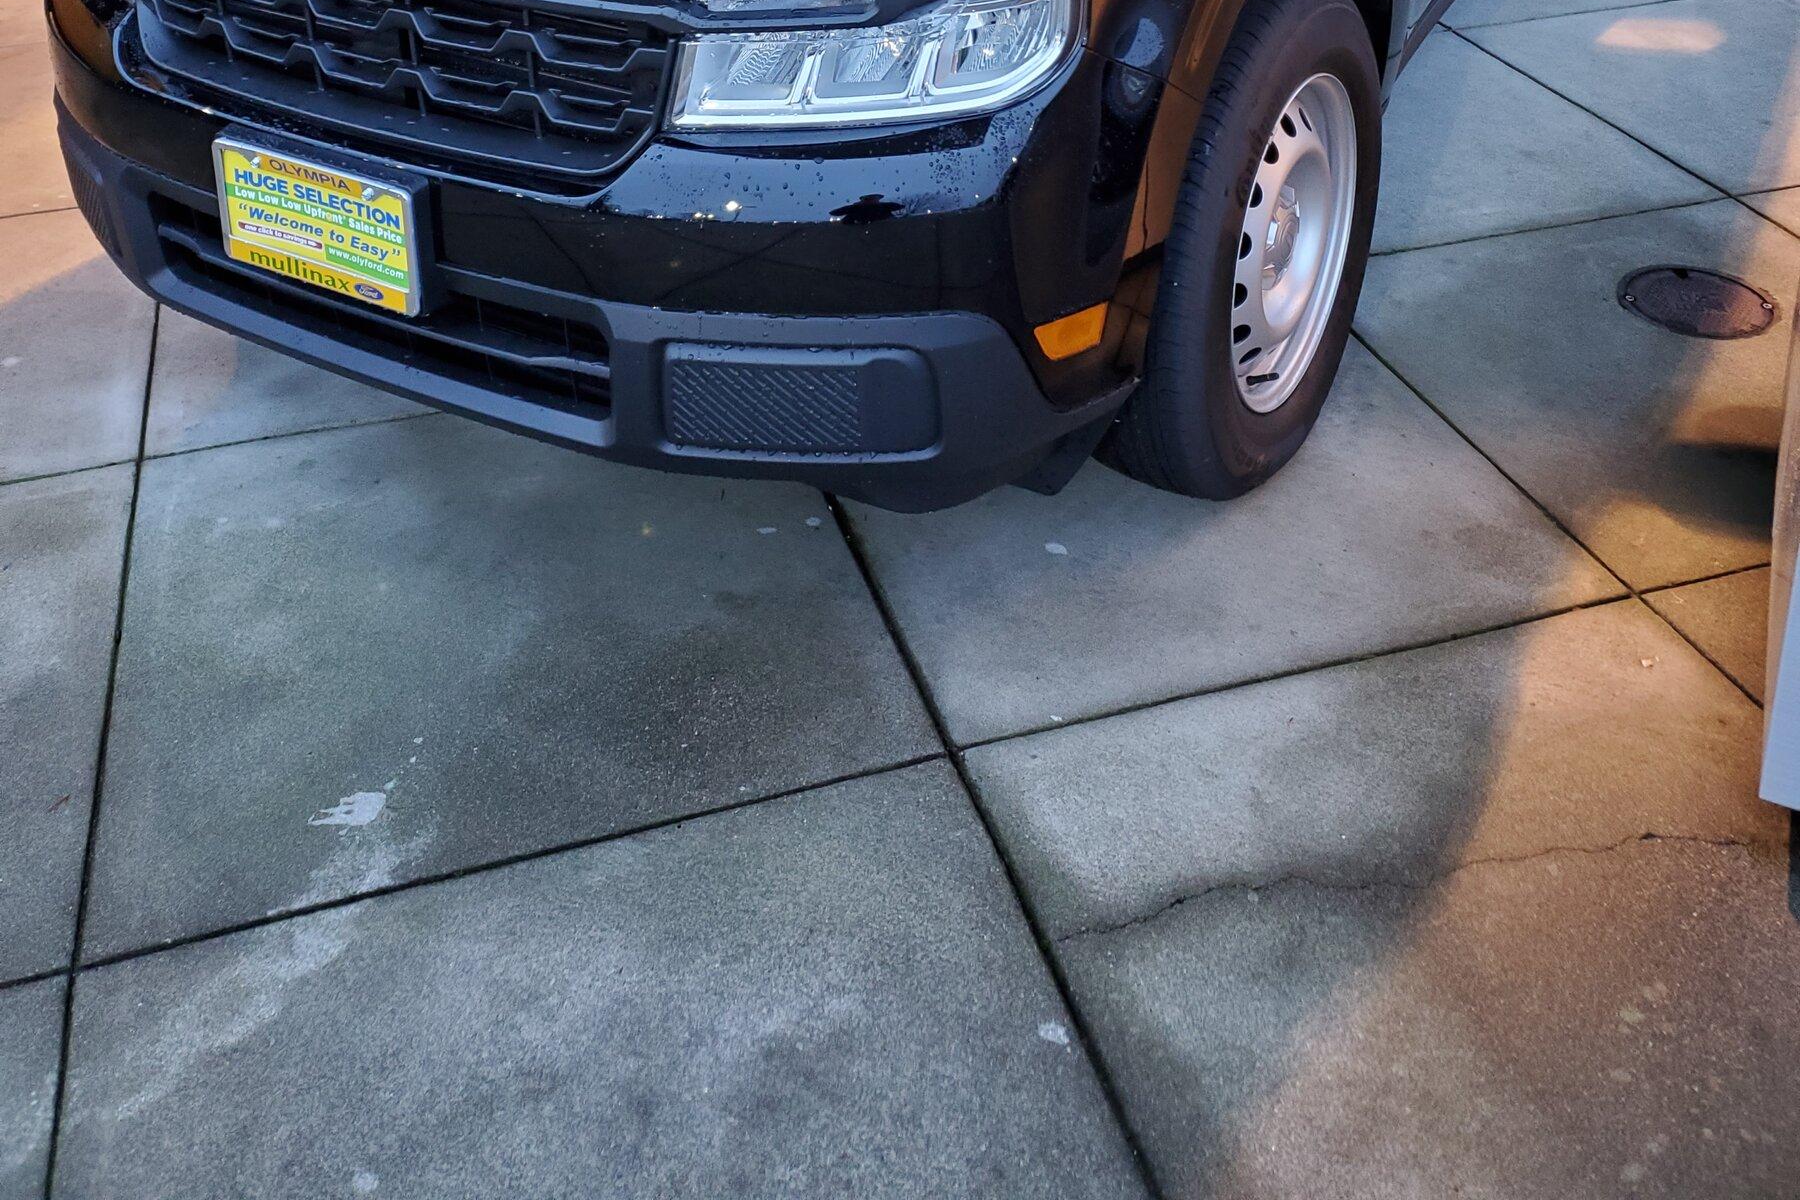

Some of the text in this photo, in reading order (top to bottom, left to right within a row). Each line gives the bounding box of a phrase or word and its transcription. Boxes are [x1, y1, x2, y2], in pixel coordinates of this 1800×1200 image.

[269, 158, 351, 192] OLYMPIA
[233, 167, 401, 231] HUGE SELECTION
[234, 185, 256, 201] Low
[258, 190, 279, 206] Low
[281, 195, 302, 212] Low
[348, 217, 375, 236] Sales
[377, 225, 403, 244] Price
[244, 224, 308, 246] one click to savings
[329, 229, 345, 244] to
[249, 250, 350, 292] mullinax
[328, 246, 405, 280] www.olyford.com
